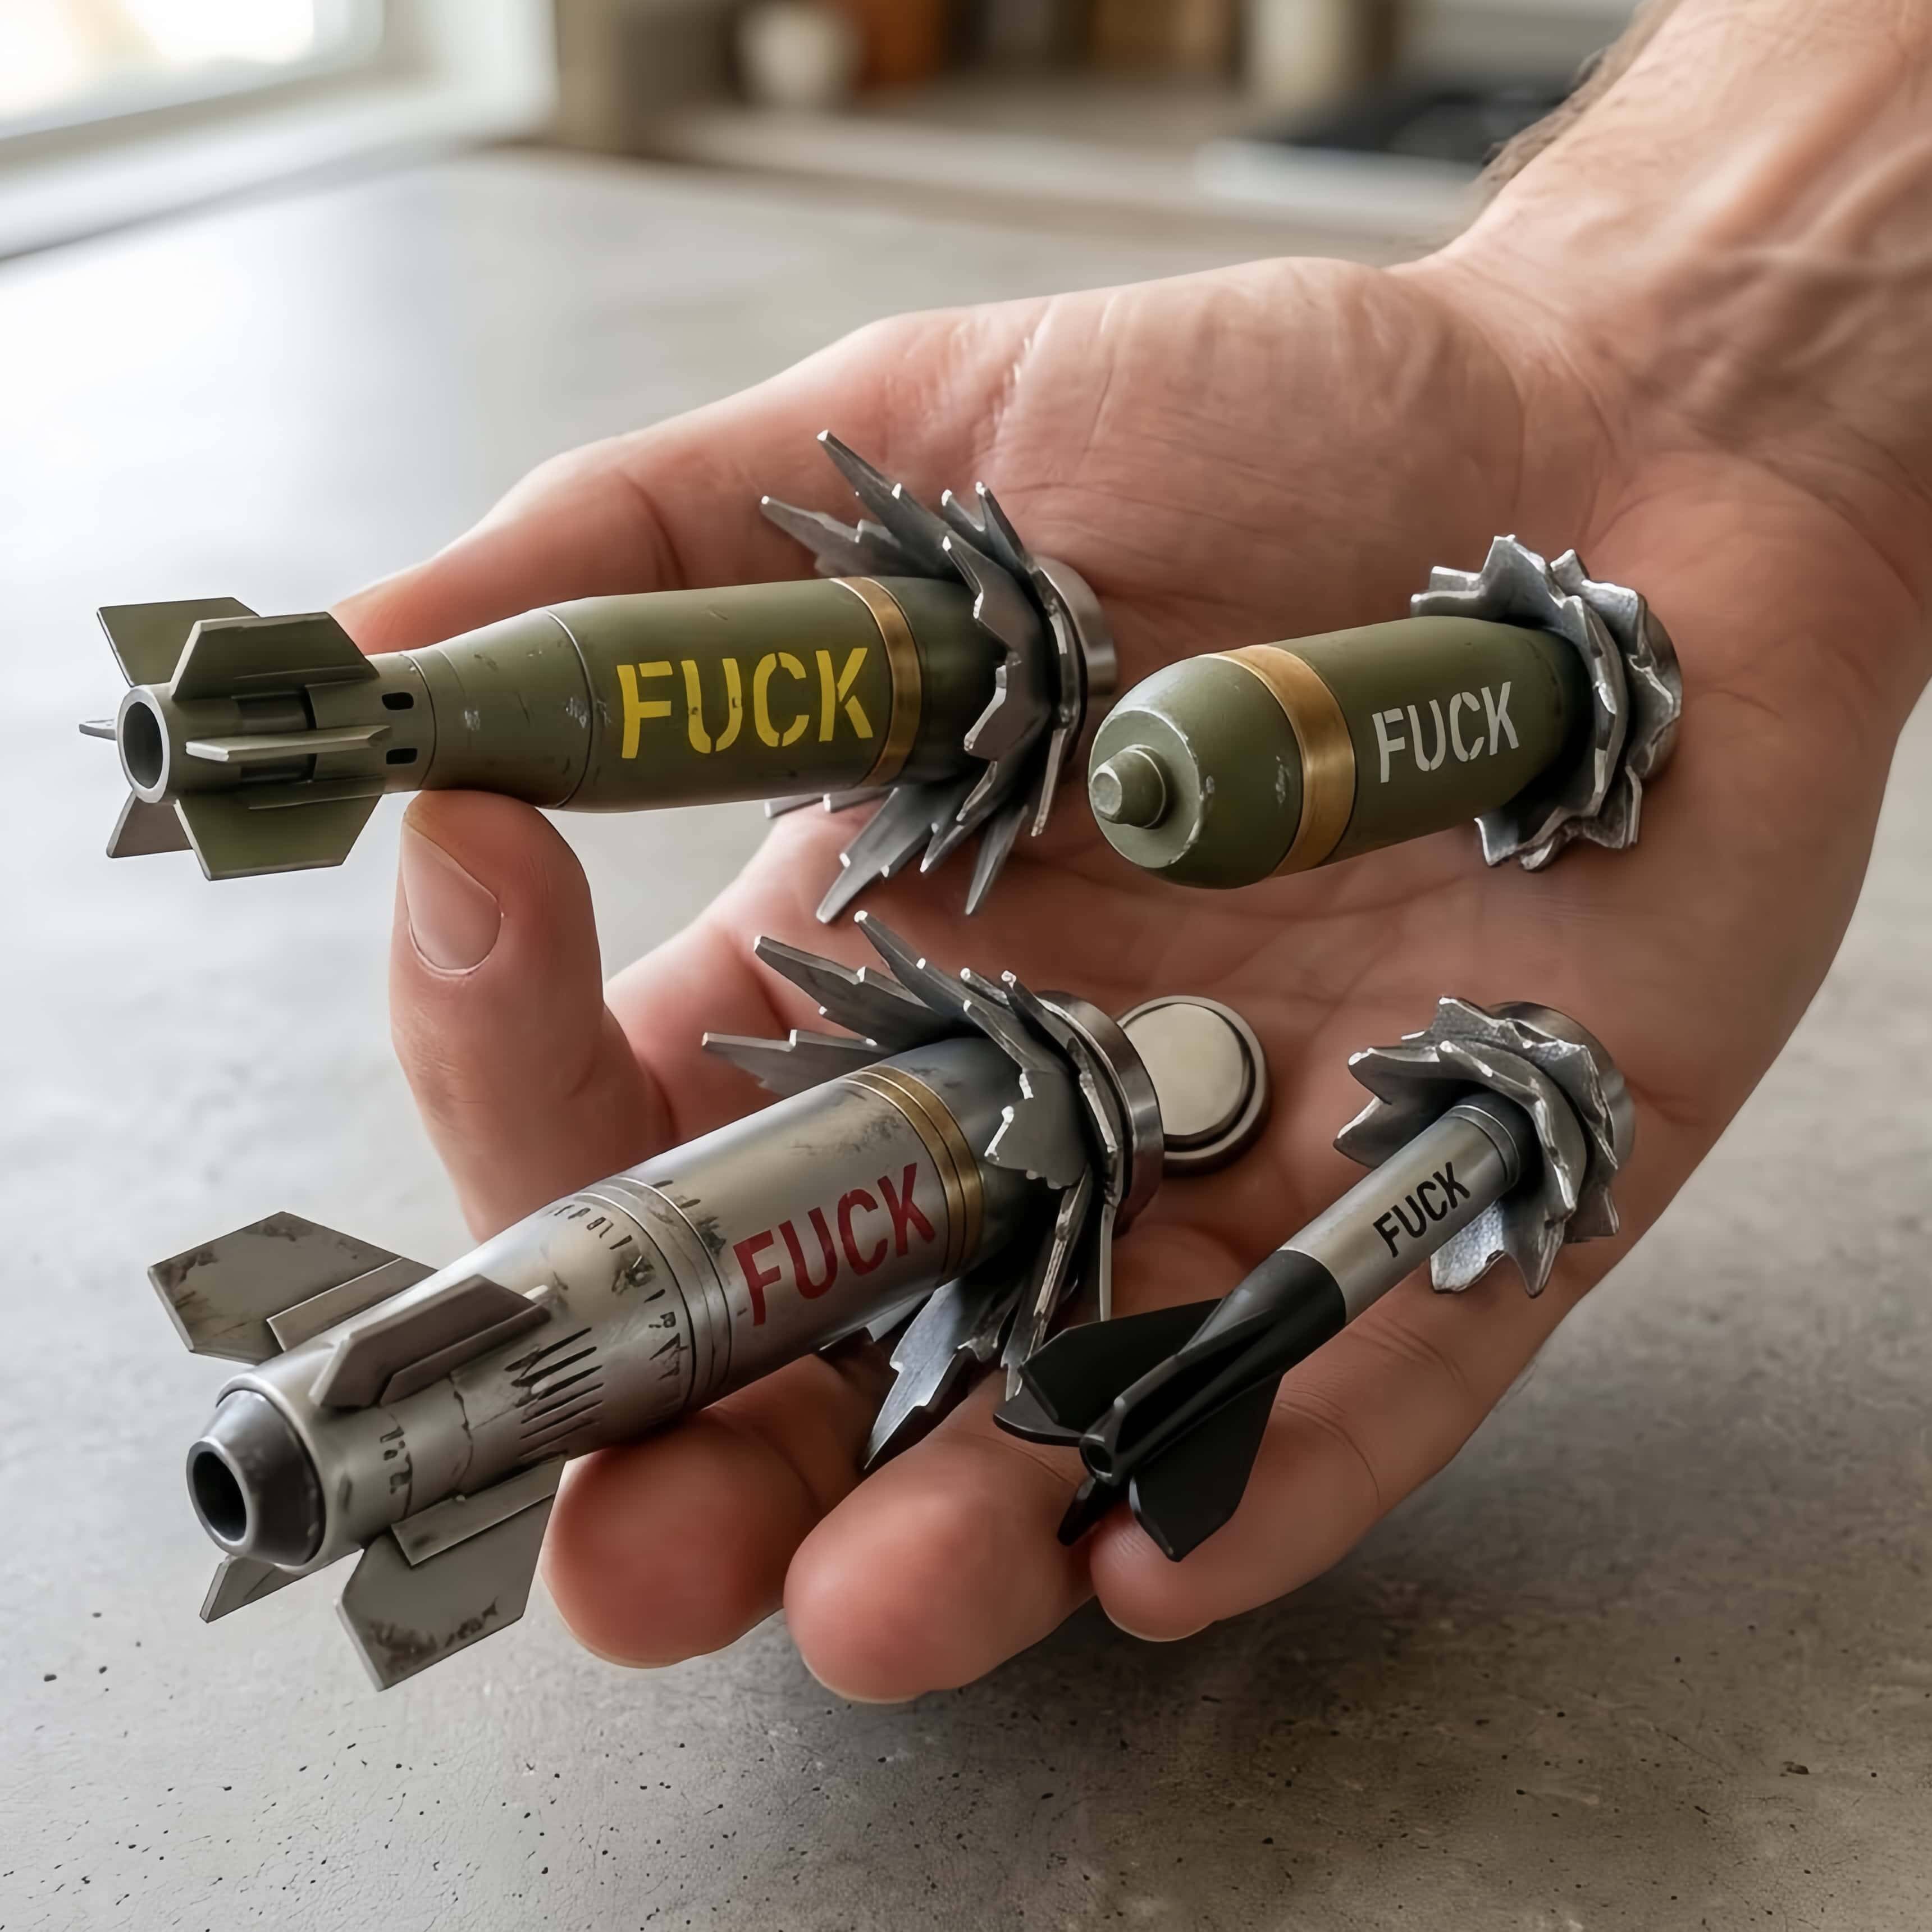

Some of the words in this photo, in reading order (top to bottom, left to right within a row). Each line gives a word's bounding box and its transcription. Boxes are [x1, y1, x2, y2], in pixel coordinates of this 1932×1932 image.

[617, 648, 873, 759] FUCK
[1372, 681, 1519, 783] FUCK
[733, 1162, 935, 1326] FUCK
[1373, 1162, 1470, 1258] FUCK
